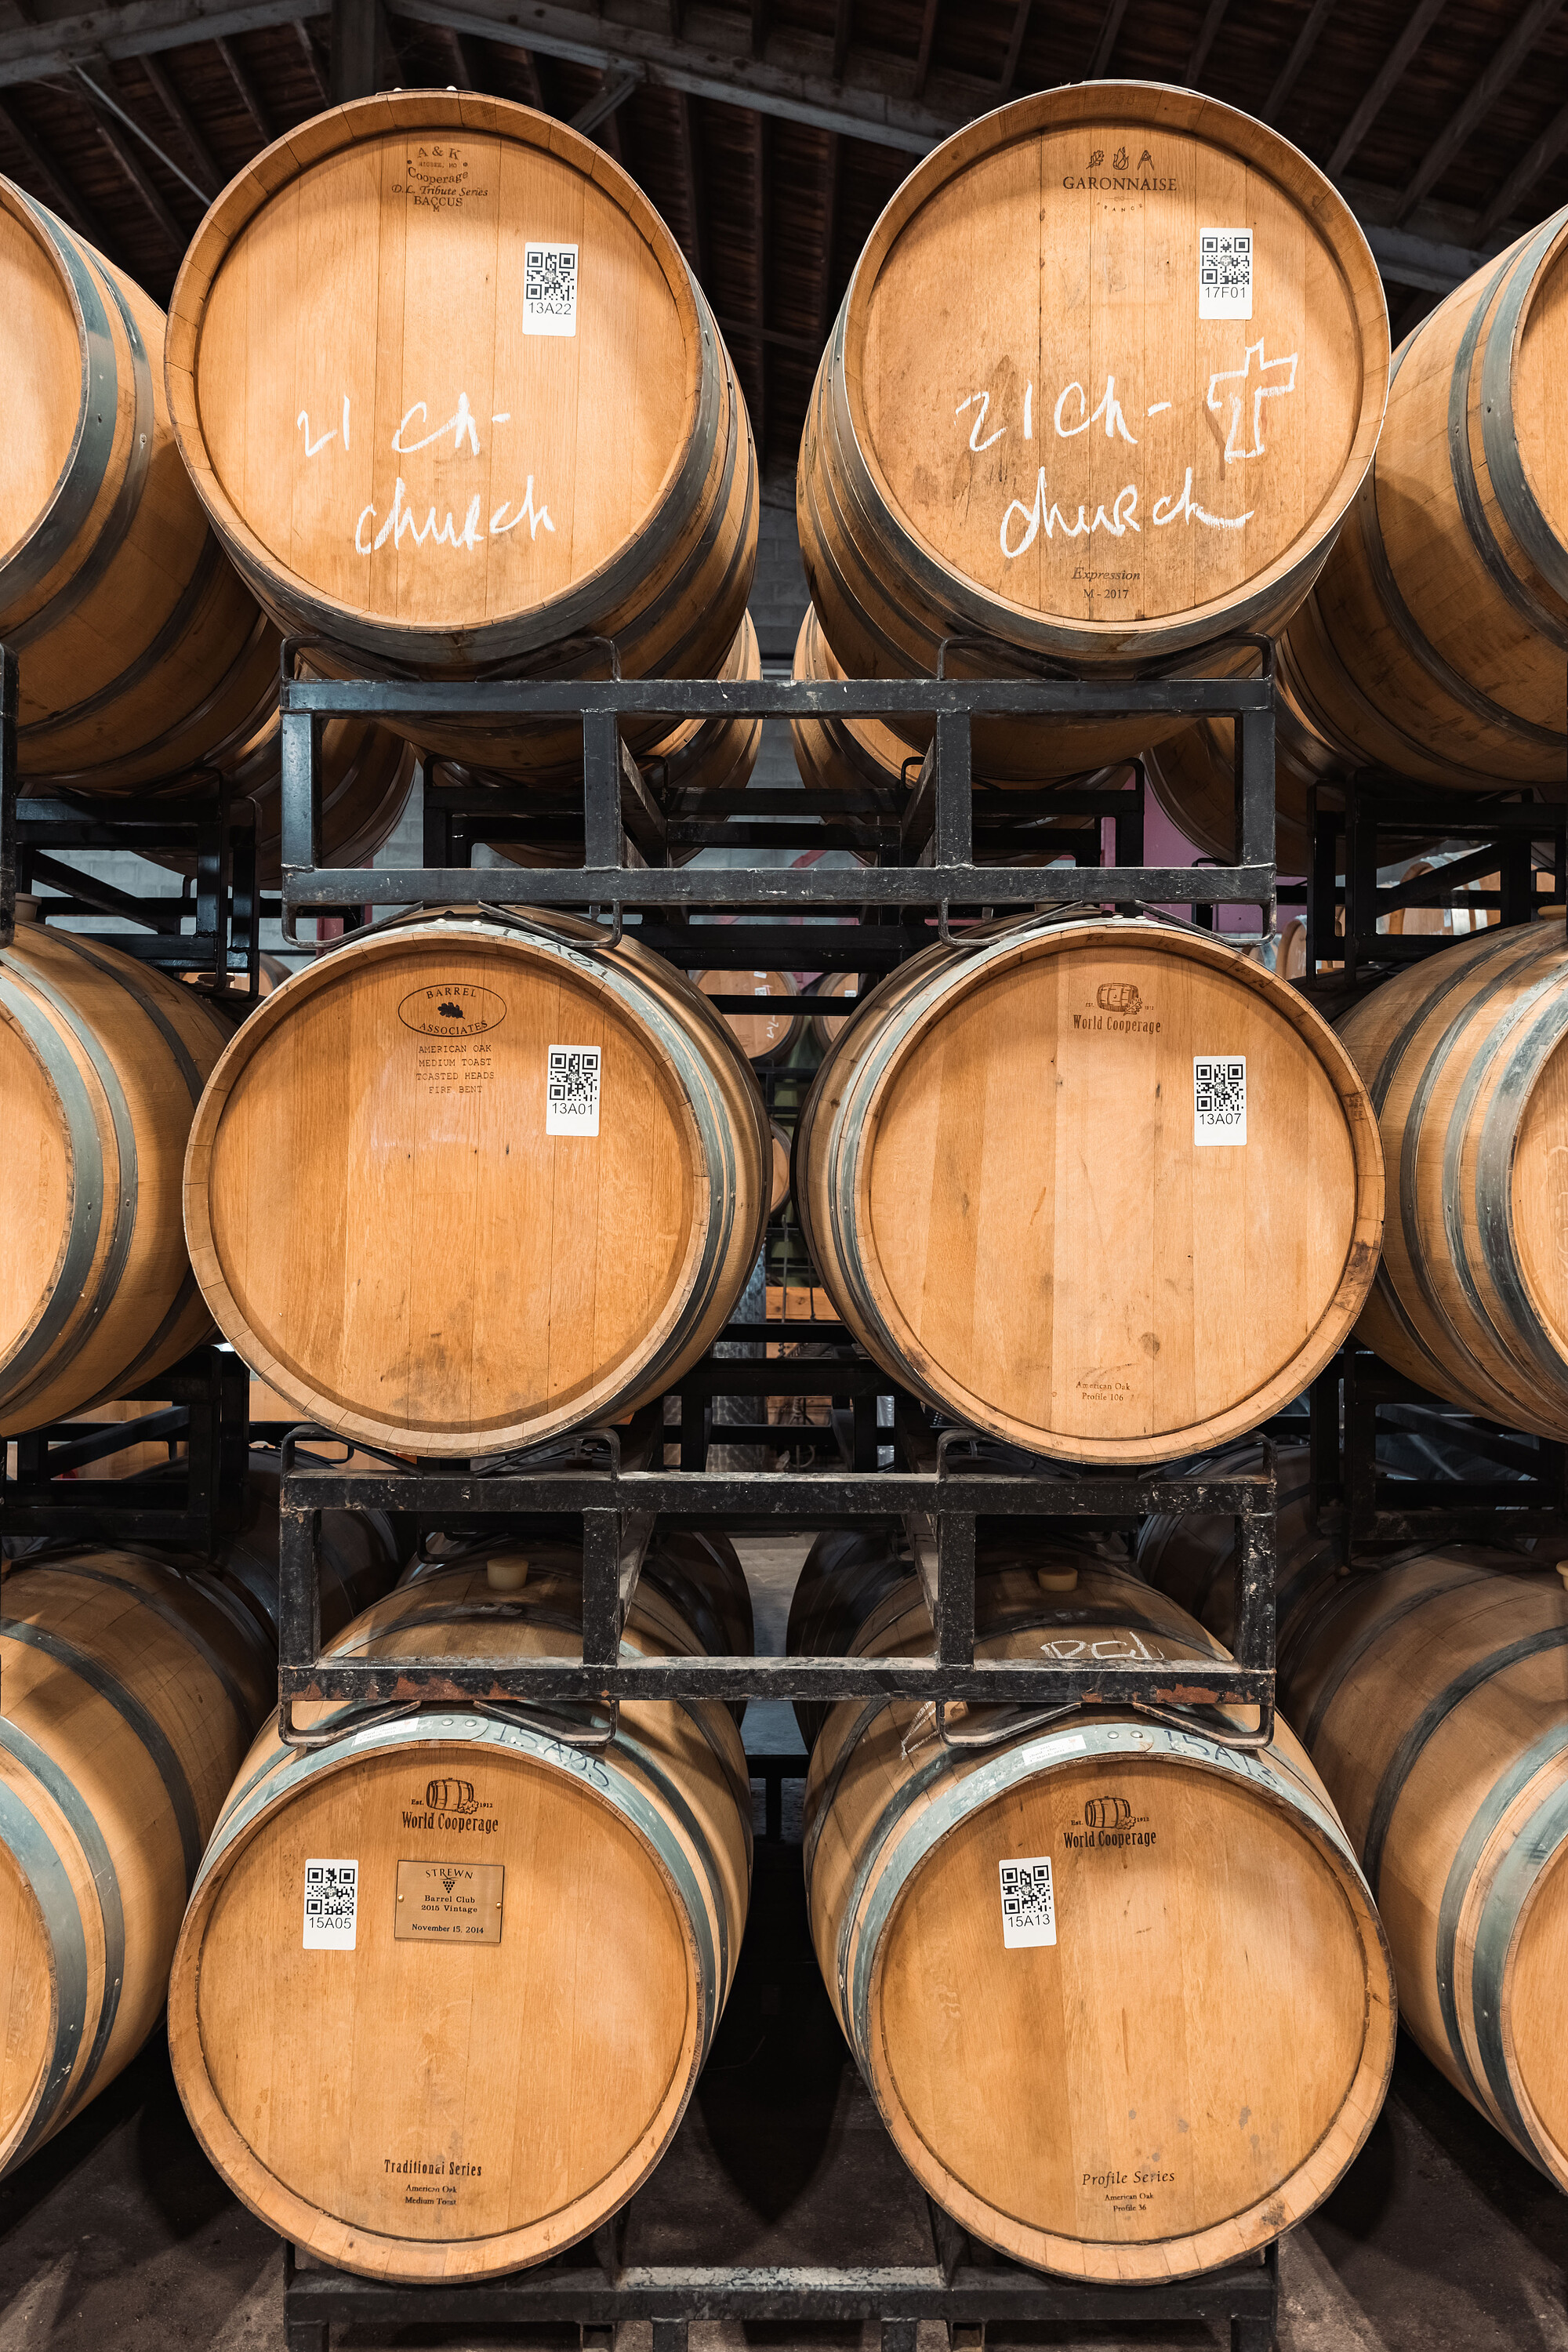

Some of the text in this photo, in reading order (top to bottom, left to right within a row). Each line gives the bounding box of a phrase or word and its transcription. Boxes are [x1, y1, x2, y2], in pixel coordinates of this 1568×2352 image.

[417, 146, 462, 160] A & K
[408, 166, 468, 185] Cooperage
[1062, 176, 1178, 191] GARONNAISE
[419, 185, 456, 194] Tribute
[459, 187, 488, 196] Series
[414, 195, 463, 206] BACCUS
[1205, 286, 1246, 298] 17F01
[528, 302, 572, 315] 13A22
[296, 394, 350, 457] 21
[1071, 566, 1141, 582] Expression
[1083, 589, 1094, 598] M
[1104, 589, 1129, 598] 2017
[426, 987, 477, 1000] BARREL
[419, 1019, 488, 1035] ASSOCIATES
[1073, 1014, 1161, 1035] World Cooperage
[418, 1044, 492, 1054] AMERICAN OAK
[419, 1058, 492, 1067] MEDIUM TOAST
[416, 1071, 495, 1080] TOASTED HEADS
[459, 1085, 483, 1094] BENT
[552, 1102, 593, 1115] 13A01
[1199, 1112, 1242, 1125] 13A07
[1076, 1381, 1112, 1390] American
[1082, 1392, 1107, 1401] Profile
[401, 1811, 499, 1835] World Cooperage
[1063, 1830, 1157, 1849] World Cooperage
[425, 1868, 474, 1880] STREWN
[424, 1894, 452, 1903] Barrel
[444, 1904, 478, 1914] Vintage
[309, 1916, 352, 1929] 15A05
[1007, 1913, 1051, 1928] 15A13
[412, 1923, 450, 1933] November
[465, 1926, 485, 1934] 2014
[384, 2159, 482, 2176] Traditional Series
[1082, 2170, 1175, 2188] Profile Series
[405, 2183, 458, 2194] American Oak
[405, 2196, 434, 2205] Medium
[1112, 2204, 1136, 2212] Profile
